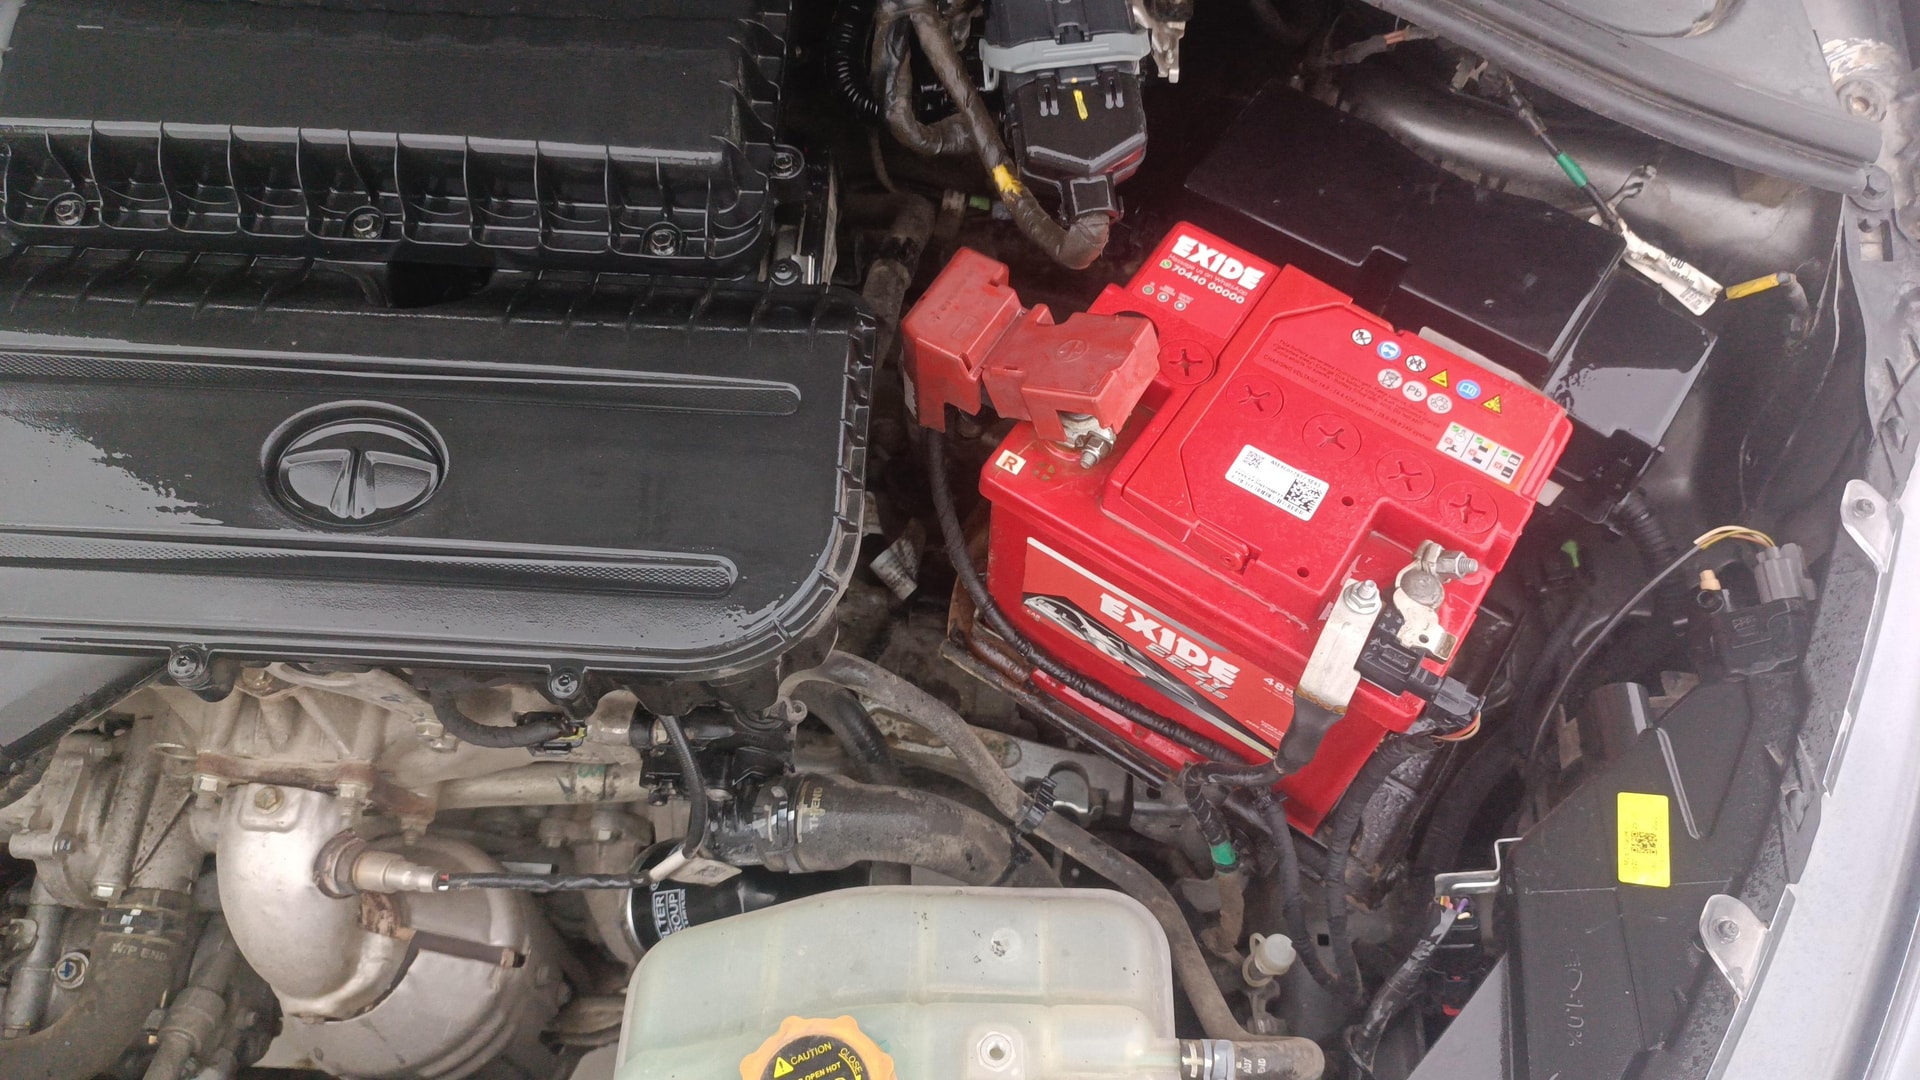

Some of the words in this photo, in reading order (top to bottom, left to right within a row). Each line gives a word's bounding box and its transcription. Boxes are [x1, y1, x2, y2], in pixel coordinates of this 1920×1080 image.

[1171, 234, 1265, 290] EXIDE
[1171, 264, 1206, 285] 70440
[1207, 282, 1245, 304] 00000
[1214, 275, 1248, 297] WhatsApp
[1406, 384, 1422, 398] Pb
[1002, 455, 1018, 472] R
[1099, 592, 1241, 686] EXIDE
[1145, 642, 1233, 694] EEZY
[1263, 677, 1285, 692] 48
[790, 1041, 832, 1066] CAUTION
[840, 1047, 863, 1073] CLOSE
[826, 1061, 842, 1074] HOT
